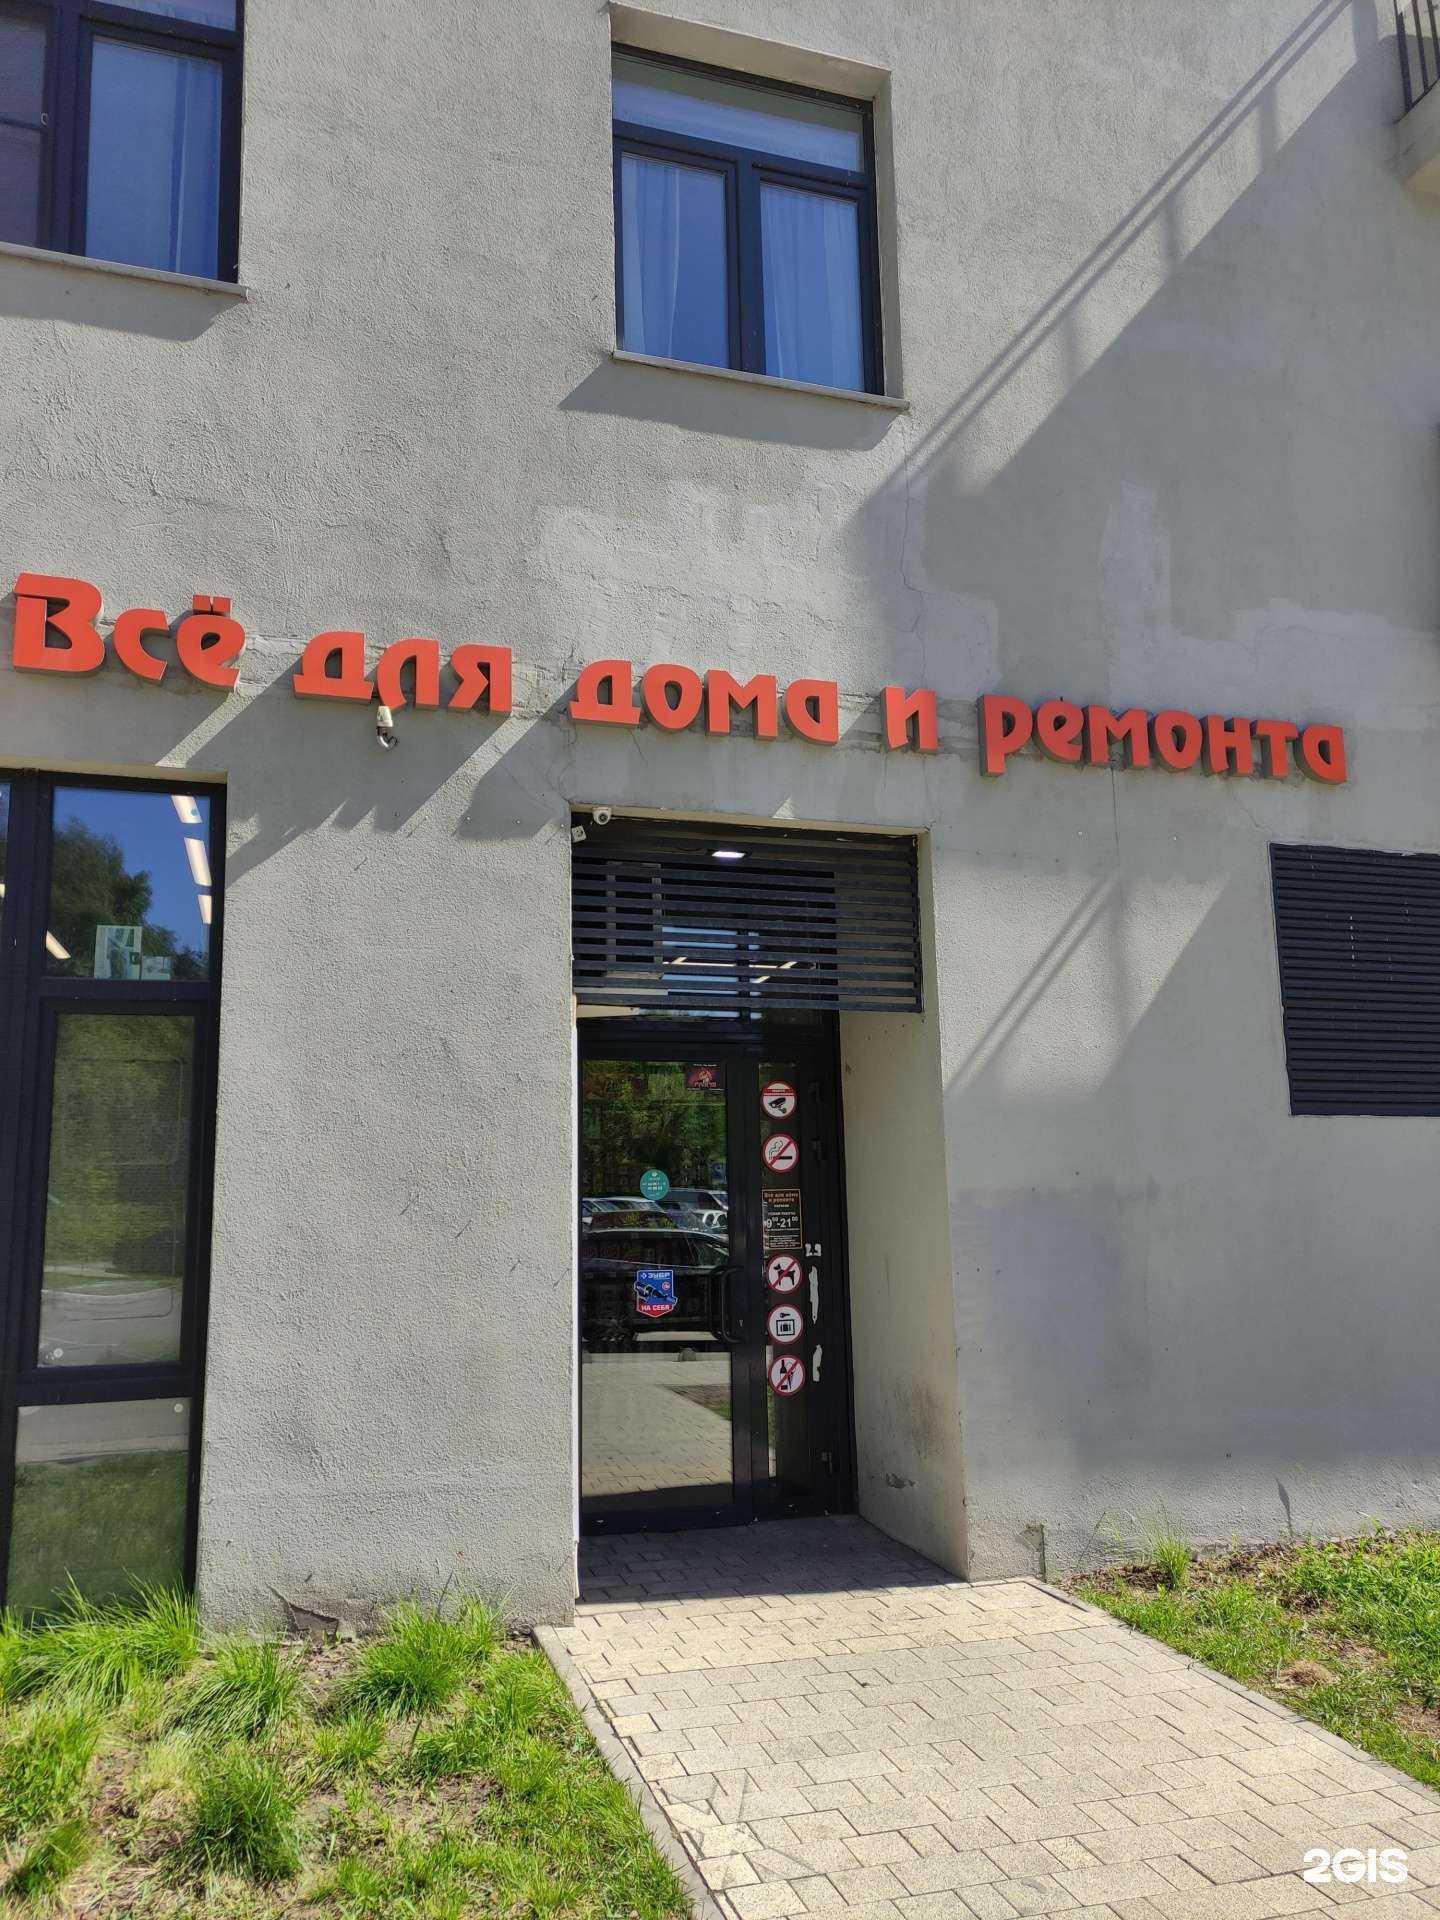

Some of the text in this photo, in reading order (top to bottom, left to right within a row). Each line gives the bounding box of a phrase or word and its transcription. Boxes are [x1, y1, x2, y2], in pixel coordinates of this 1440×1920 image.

[13, 572, 1347, 783] Всё для дома и ремонта
